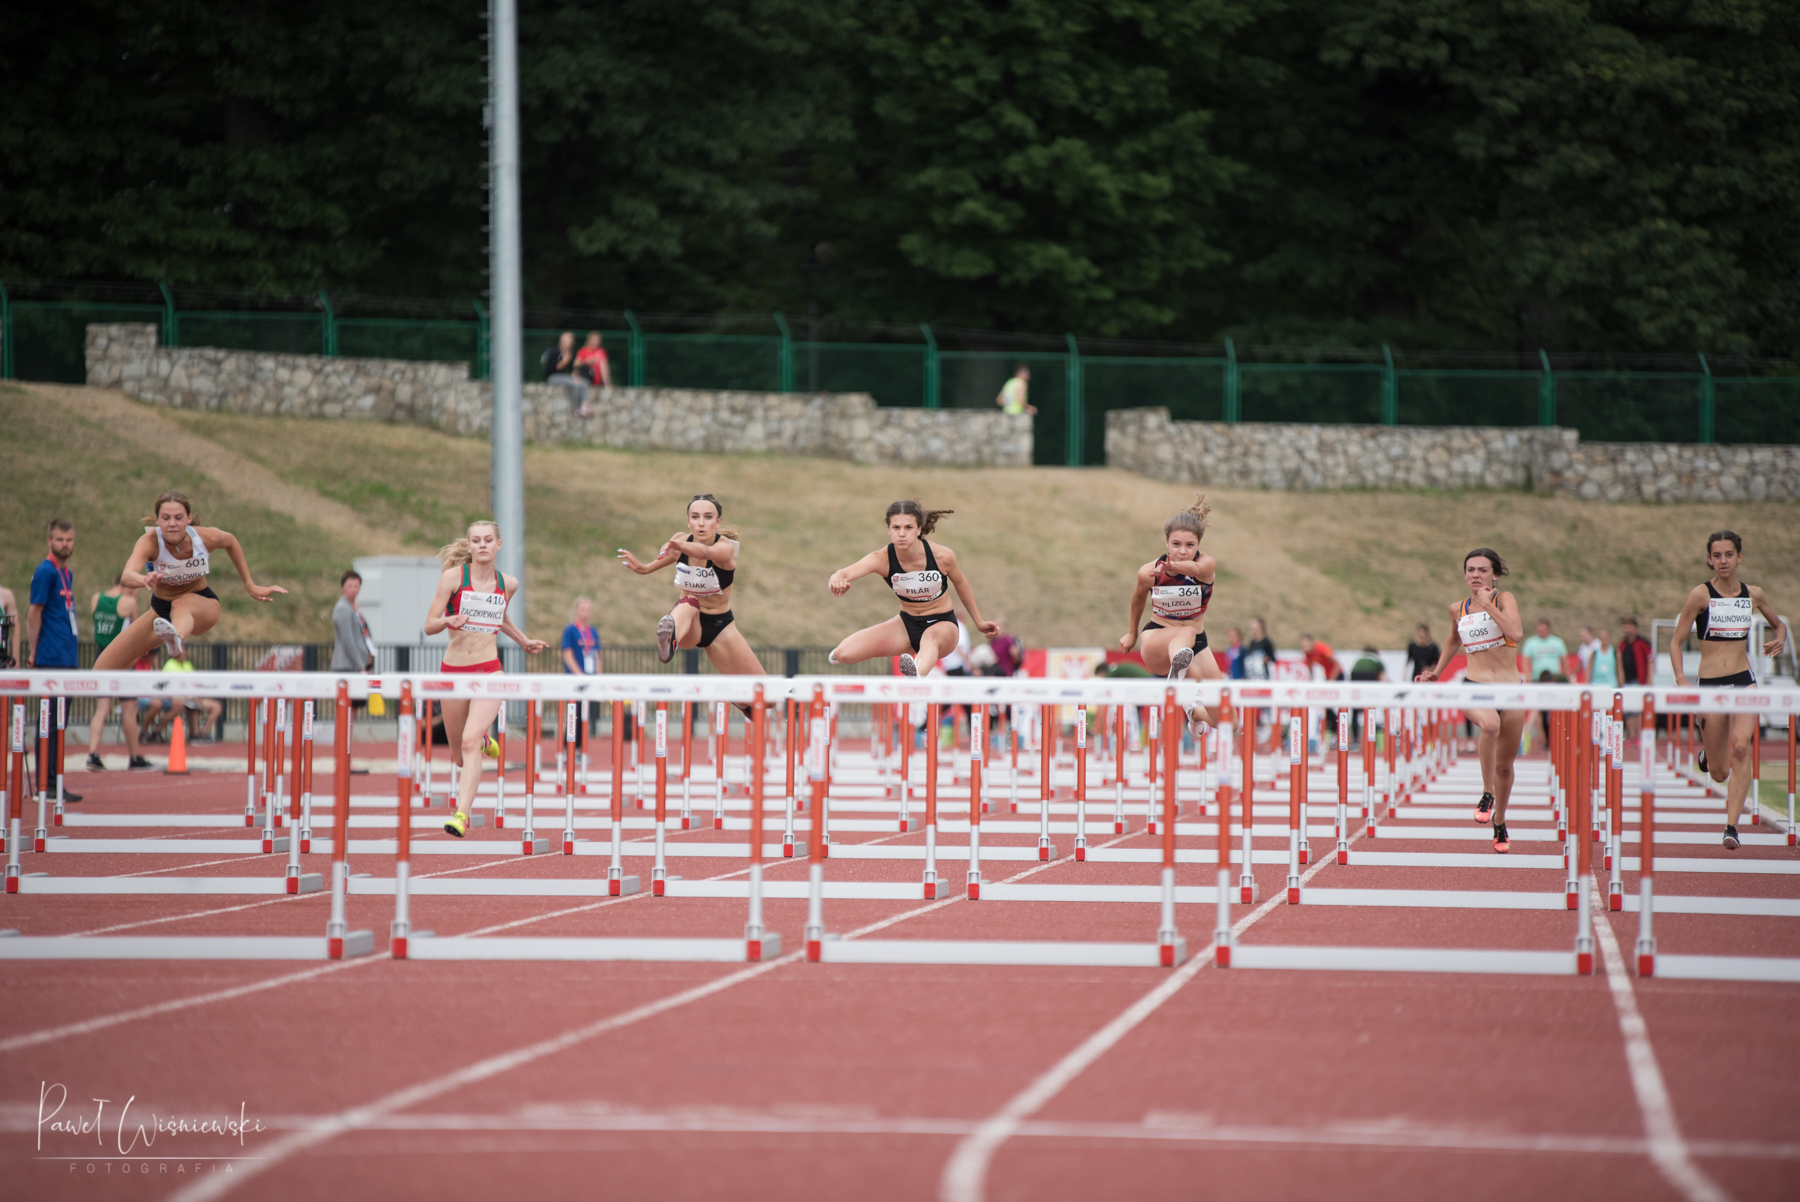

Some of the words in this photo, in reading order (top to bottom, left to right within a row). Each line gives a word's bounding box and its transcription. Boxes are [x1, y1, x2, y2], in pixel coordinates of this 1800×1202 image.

[185, 557, 206, 568] 601
[696, 567, 715, 578] 304
[918, 572, 940, 582] 360
[684, 581, 707, 590] FIJAK
[905, 587, 930, 595] FILAR
[1178, 587, 1200, 597] 364
[486, 595, 505, 606] 410
[1734, 599, 1751, 608] 423
[460, 607, 503, 620] ZACZKIEWICZ
[1710, 615, 1751, 623] MALINOWSKA
[1469, 627, 1489, 638] GOSS
